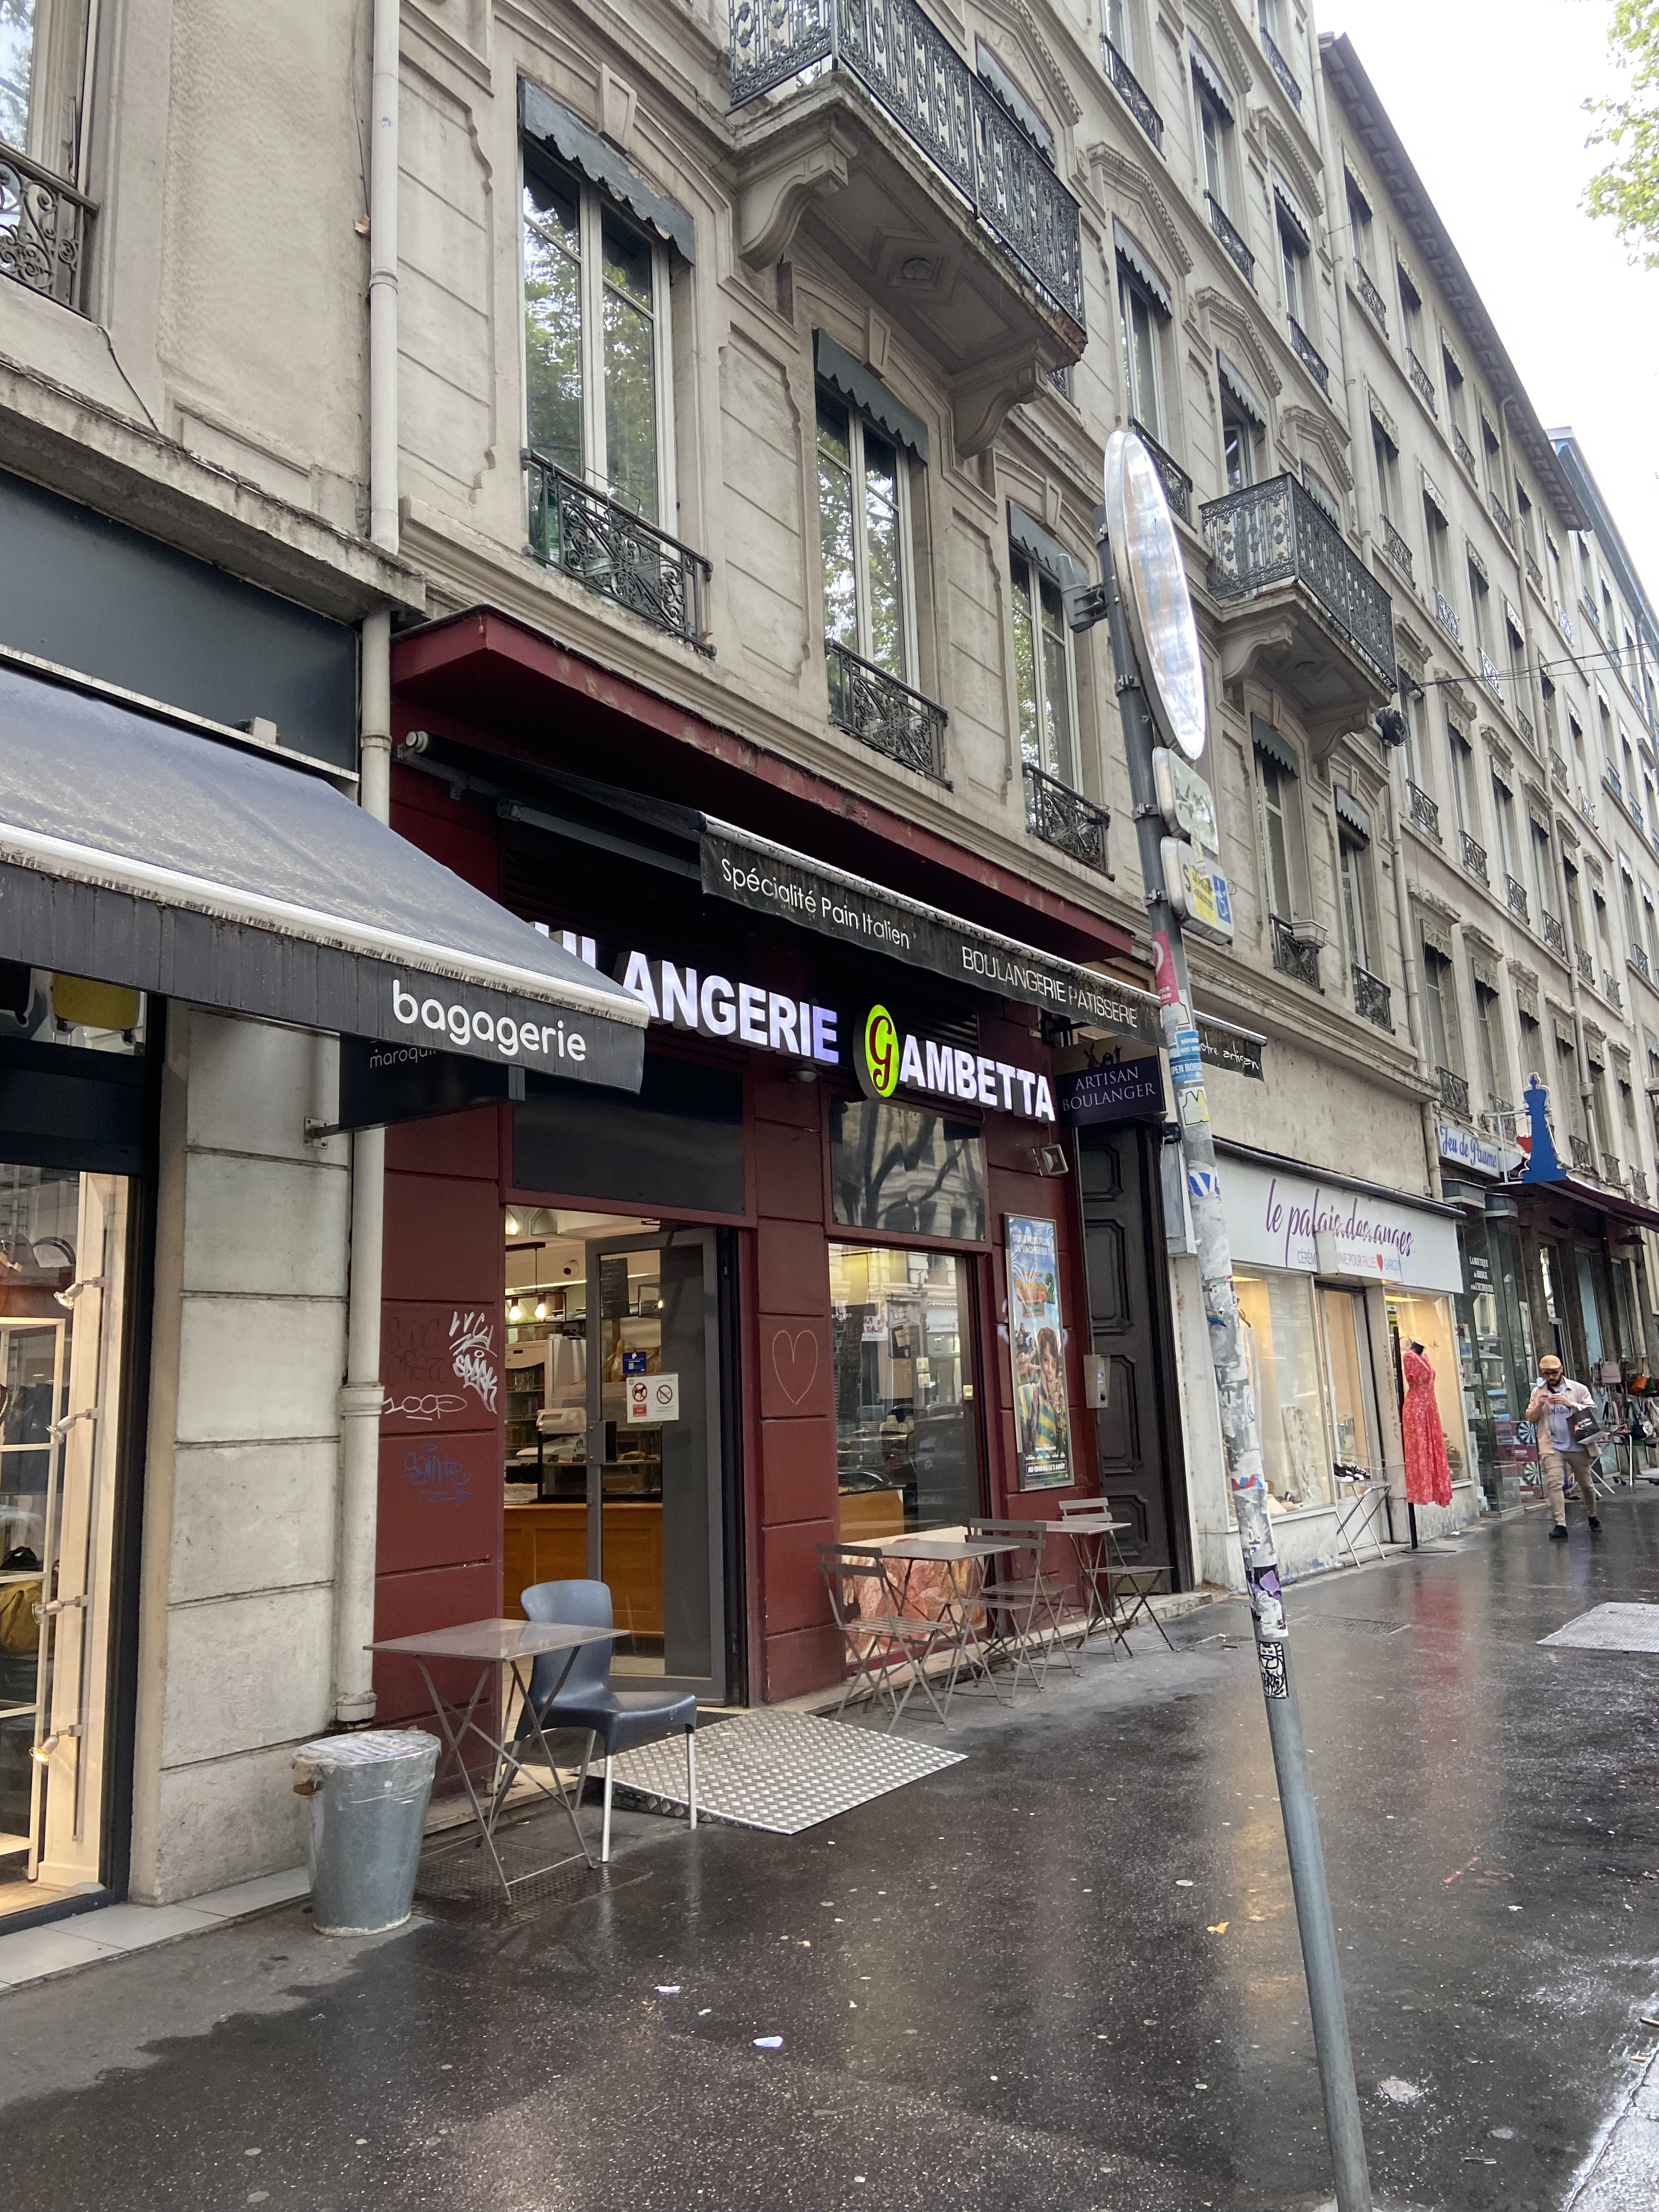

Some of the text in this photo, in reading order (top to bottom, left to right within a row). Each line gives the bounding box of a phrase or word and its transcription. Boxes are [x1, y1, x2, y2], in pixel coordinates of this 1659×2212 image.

[721, 858, 910, 949] Spécialité Pain Italien
[962, 945, 1138, 1028] BOULANGERIE PATISSERIE
[392, 979, 586, 1062] bagagerie
[1074, 1066, 1139, 1092] ARTISAN
[1222, 1040, 1260, 1070] artisan
[1062, 1082, 1156, 1111] BOULANGER
[1439, 1125, 1497, 1169] Jeu de Paume
[1266, 1178, 1283, 1233] le
[1285, 1187, 1343, 1268] palais
